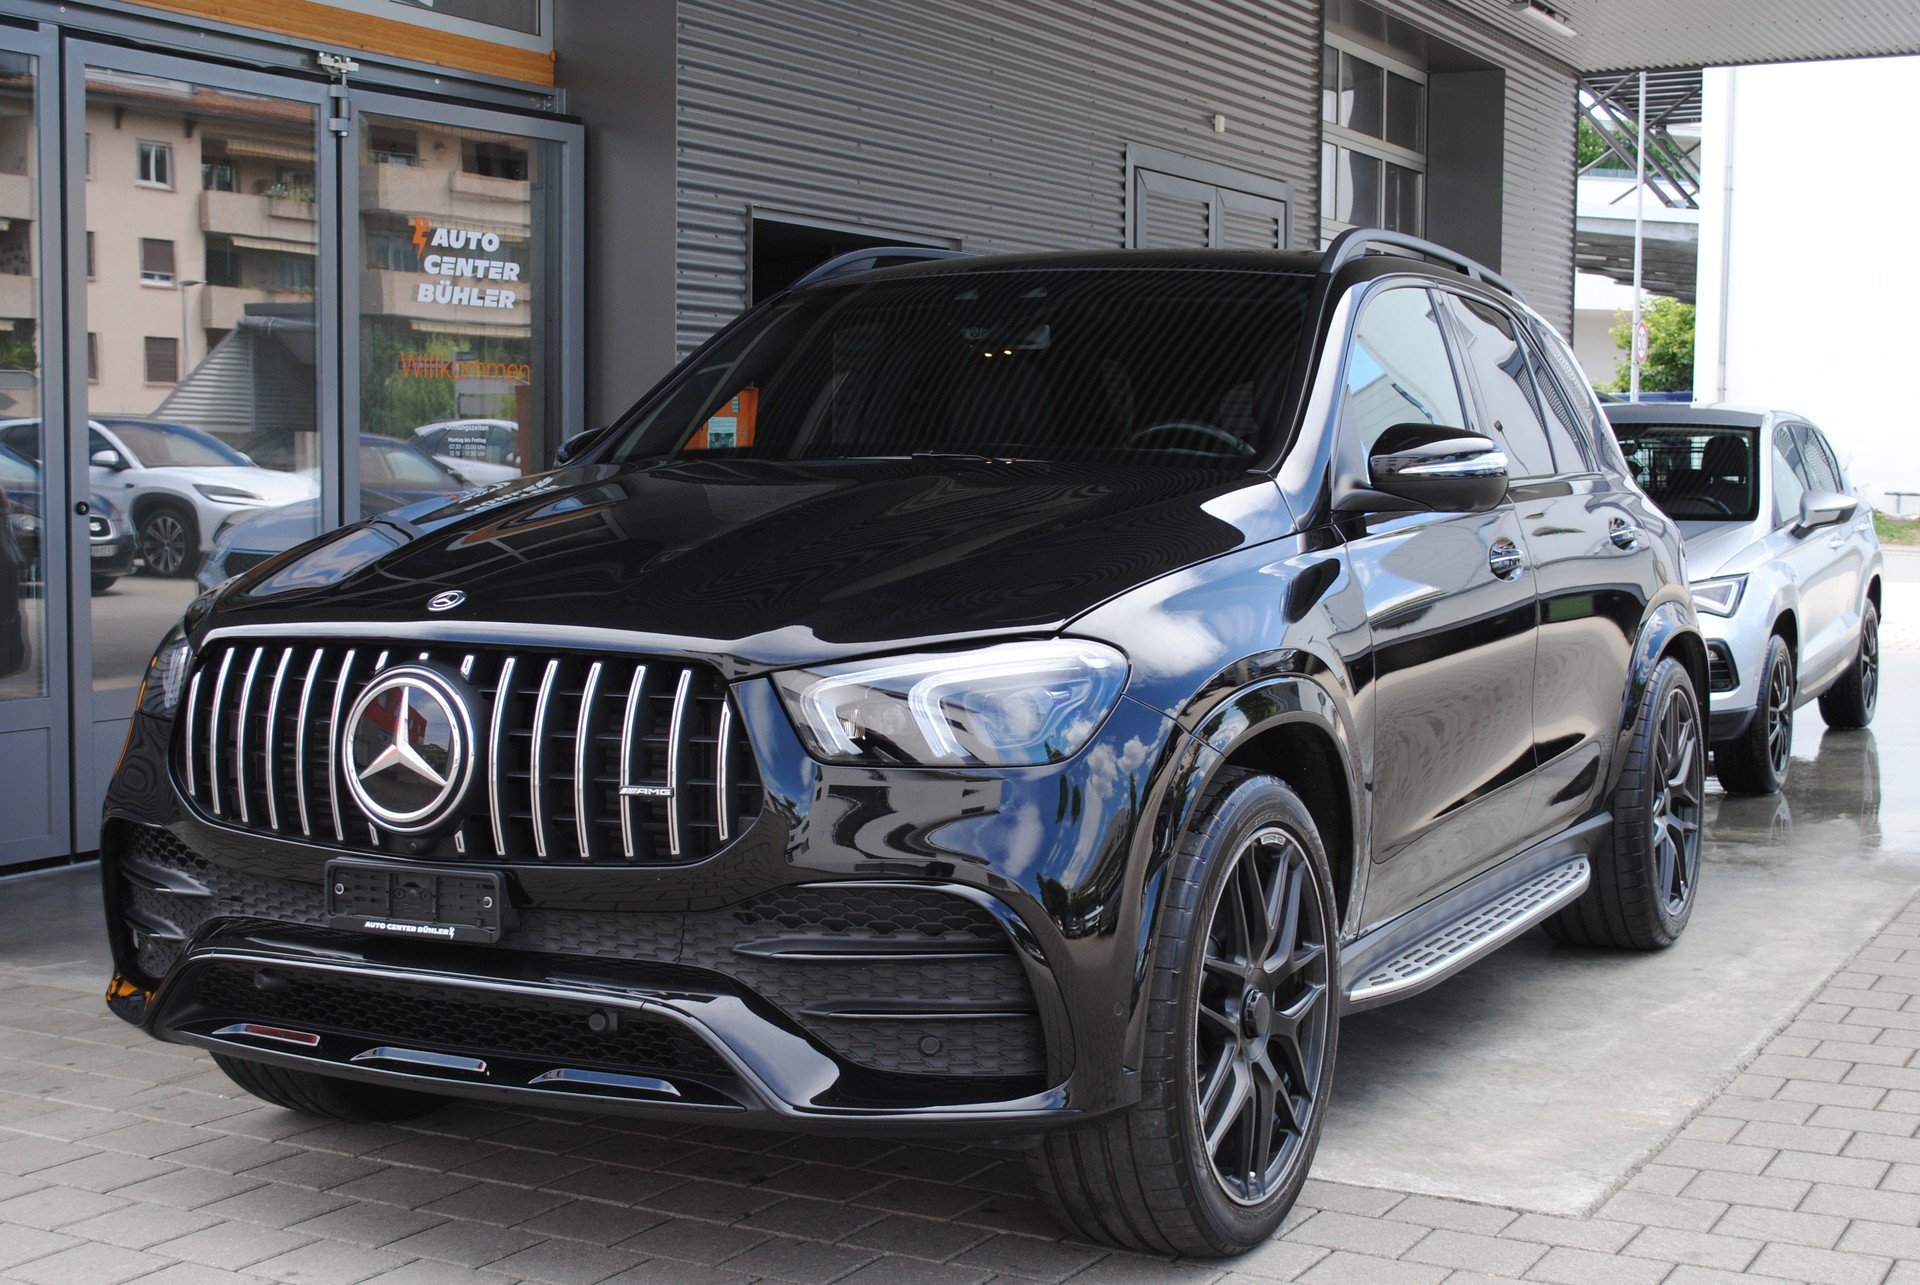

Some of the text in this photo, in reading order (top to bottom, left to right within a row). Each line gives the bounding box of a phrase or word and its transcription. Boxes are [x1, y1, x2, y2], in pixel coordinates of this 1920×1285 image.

[431, 228, 500, 252] AUTO
[424, 255, 520, 281] CENTER
[417, 279, 516, 308] BÜHLER
[400, 351, 531, 385] Willkommen
[364, 921, 449, 935] AUTO CENTER BÜHLER
